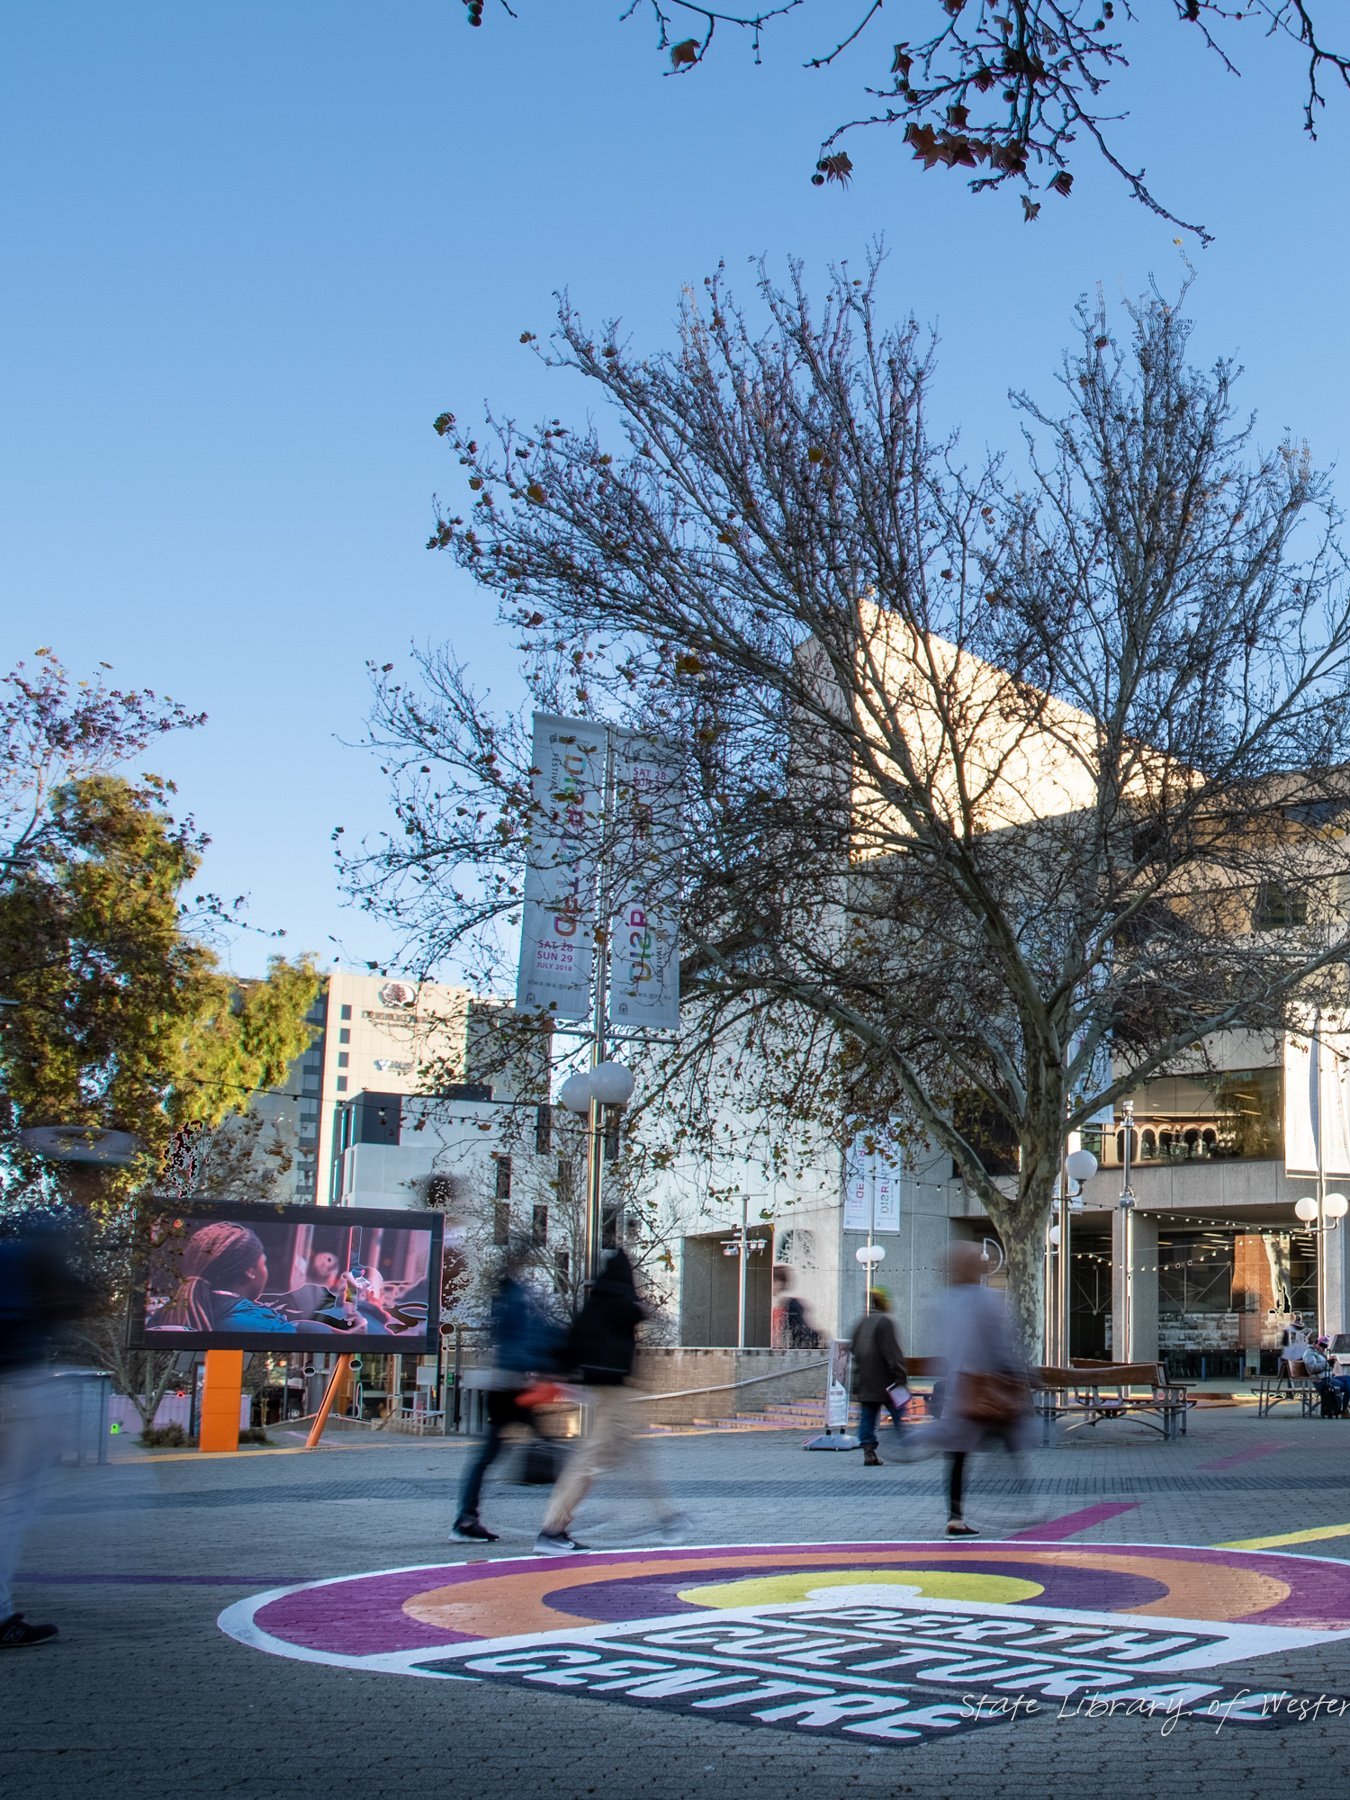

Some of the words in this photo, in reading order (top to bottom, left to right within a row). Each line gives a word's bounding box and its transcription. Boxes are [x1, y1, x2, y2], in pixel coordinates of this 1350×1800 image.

[633, 767, 651, 778] SAT
[655, 771, 667, 780] 28
[538, 940, 557, 949] SAT
[561, 942, 574, 952] 28
[537, 951, 558, 961] SUN
[561, 953, 573, 962] 29
[555, 963, 573, 971] 2018
[789, 1609, 1197, 1660] PERTH
[643, 1625, 1296, 1722] CULTURAL
[465, 1650, 1006, 1738] CENTRE
